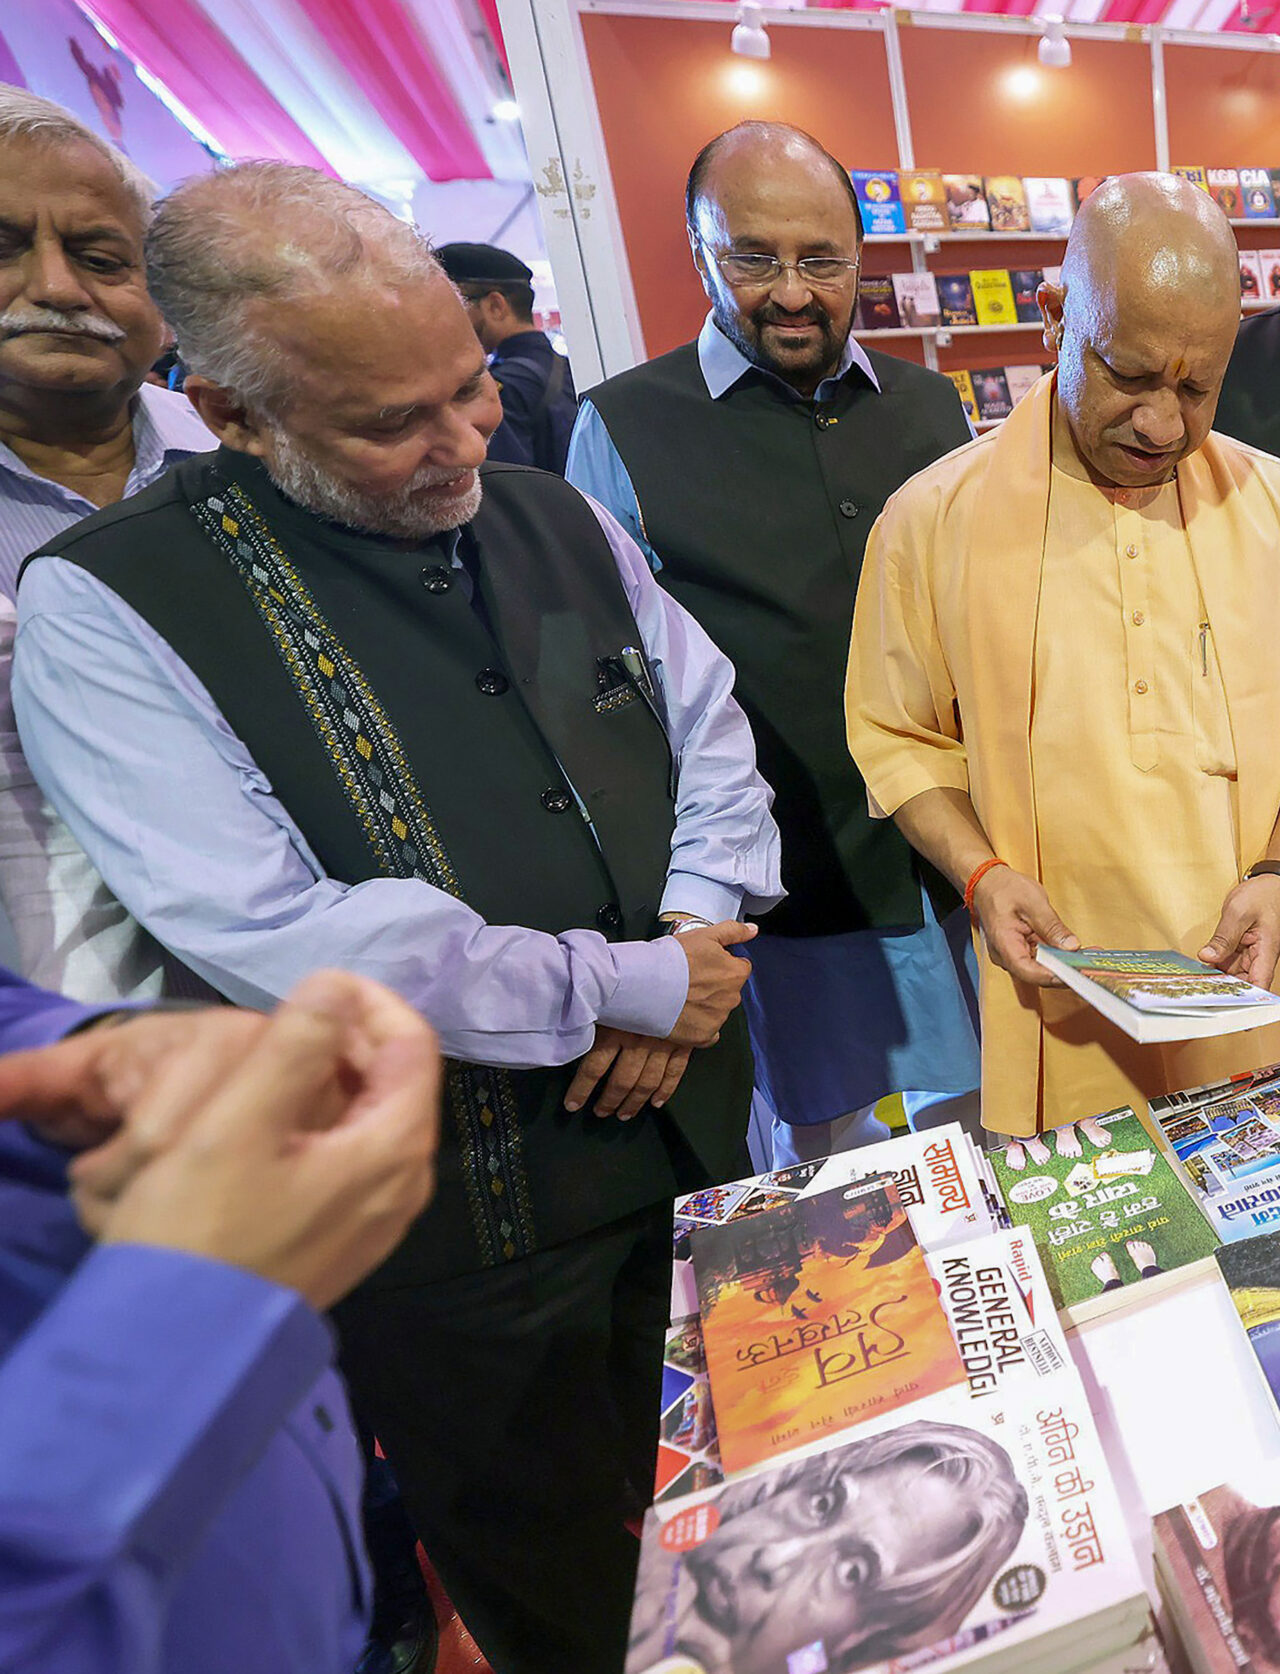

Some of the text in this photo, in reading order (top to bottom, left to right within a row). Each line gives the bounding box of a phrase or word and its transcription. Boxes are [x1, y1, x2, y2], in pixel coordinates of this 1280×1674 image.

[1206, 168, 1239, 186] KGB
[1239, 168, 1270, 187] CIA
[923, 1138, 971, 1214] सामान्य
[1047, 1181, 1141, 1221] प्यार के
[1122, 1196, 1162, 1219] हम
[1047, 1219, 1095, 1247] राही
[1009, 1238, 1033, 1282] Rapid
[736, 1309, 869, 1372] लखनऊ
[975, 1266, 1026, 1374] GENERAL
[814, 1294, 912, 1390] लव
[1025, 1336, 1052, 1377] BESTSELLE
[1036, 1406, 1105, 1571] अग्नि की उड़ान
